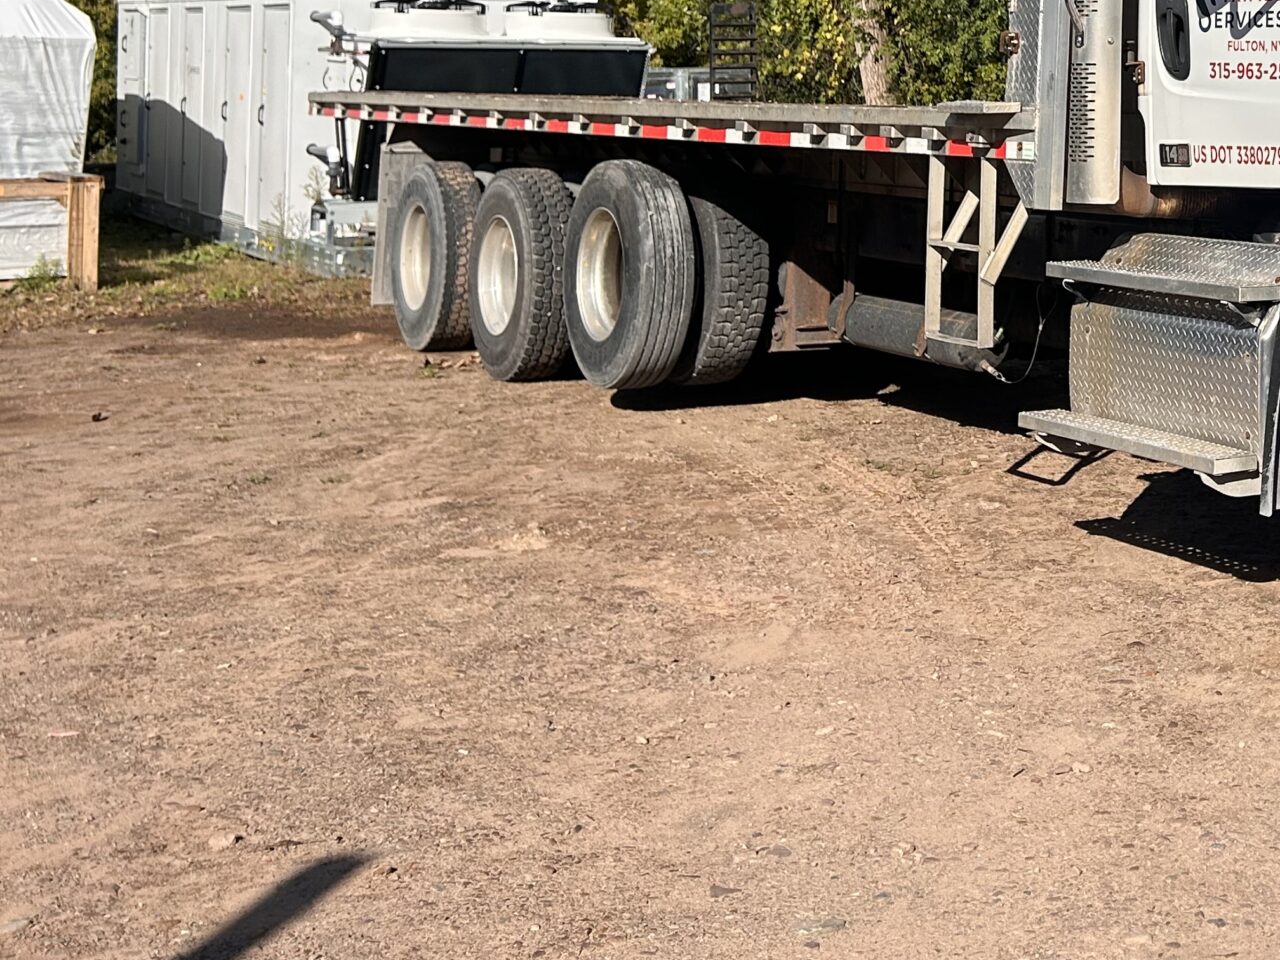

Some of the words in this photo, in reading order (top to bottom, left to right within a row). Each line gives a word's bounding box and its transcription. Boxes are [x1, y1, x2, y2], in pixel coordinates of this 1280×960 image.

[1227, 40, 1268, 53] FULTON,
[1193, 145, 1207, 163] US
[1210, 145, 1233, 164] DOT
